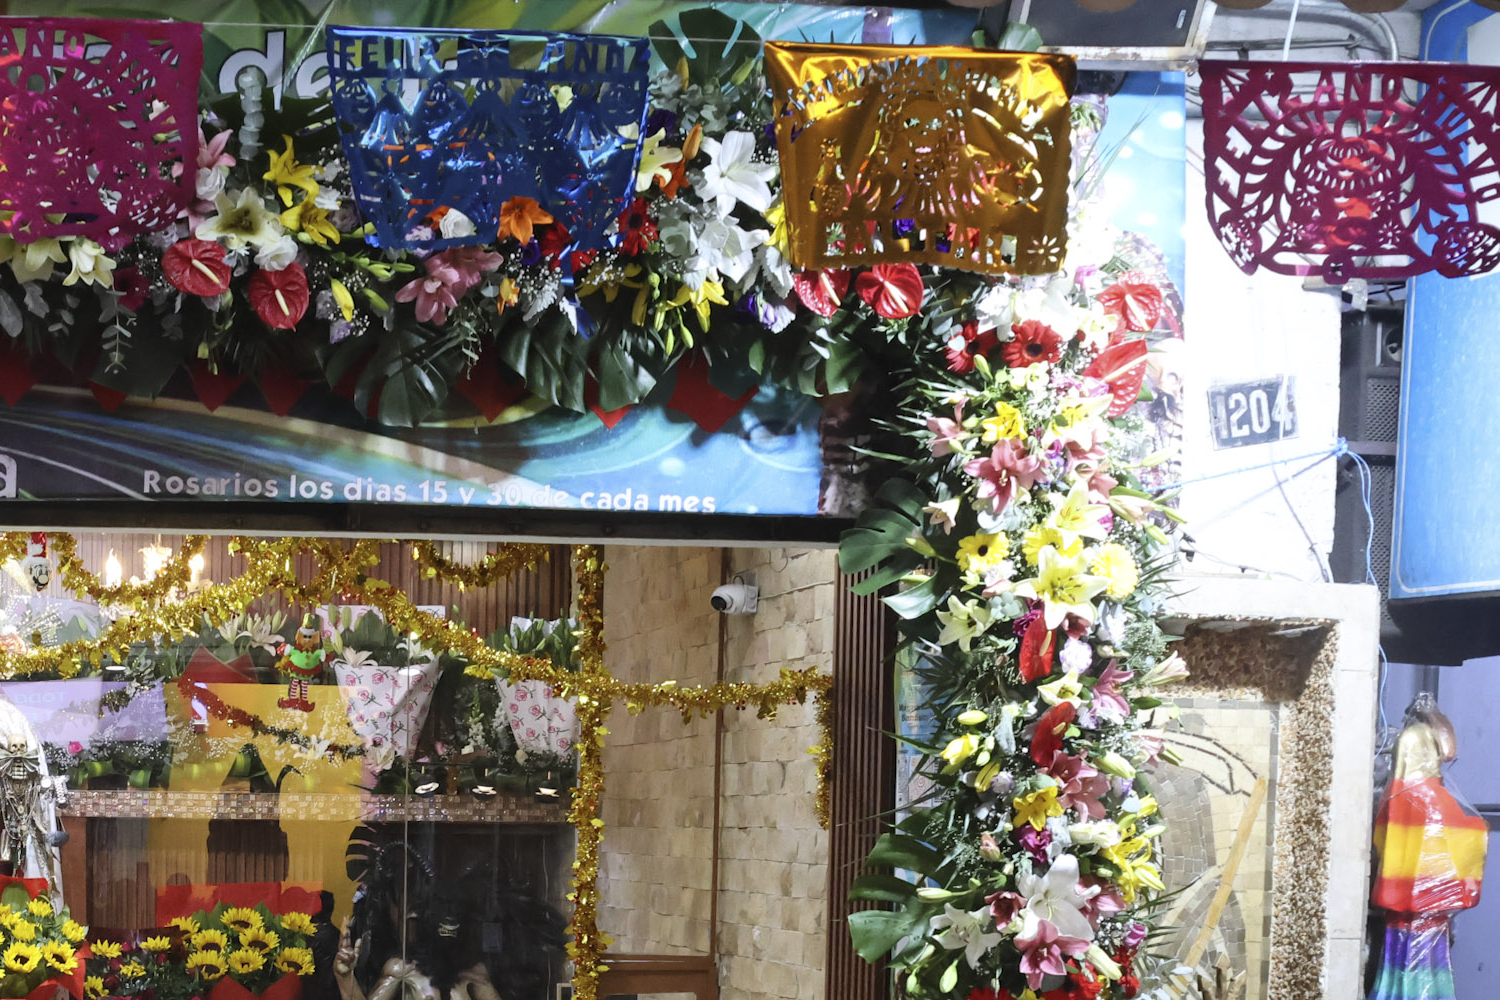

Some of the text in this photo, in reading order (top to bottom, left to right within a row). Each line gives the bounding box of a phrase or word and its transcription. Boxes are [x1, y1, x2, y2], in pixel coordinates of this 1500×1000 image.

[1214, 382, 1294, 440] 1204
[143, 469, 278, 498] Rosarios
[289, 475, 333, 500] los
[418, 480, 447, 504] 15
[459, 485, 475, 506] y
[486, 484, 521, 506] 30
[531, 482, 568, 508] de
[580, 486, 649, 511] cada
[658, 493, 716, 514] mes
